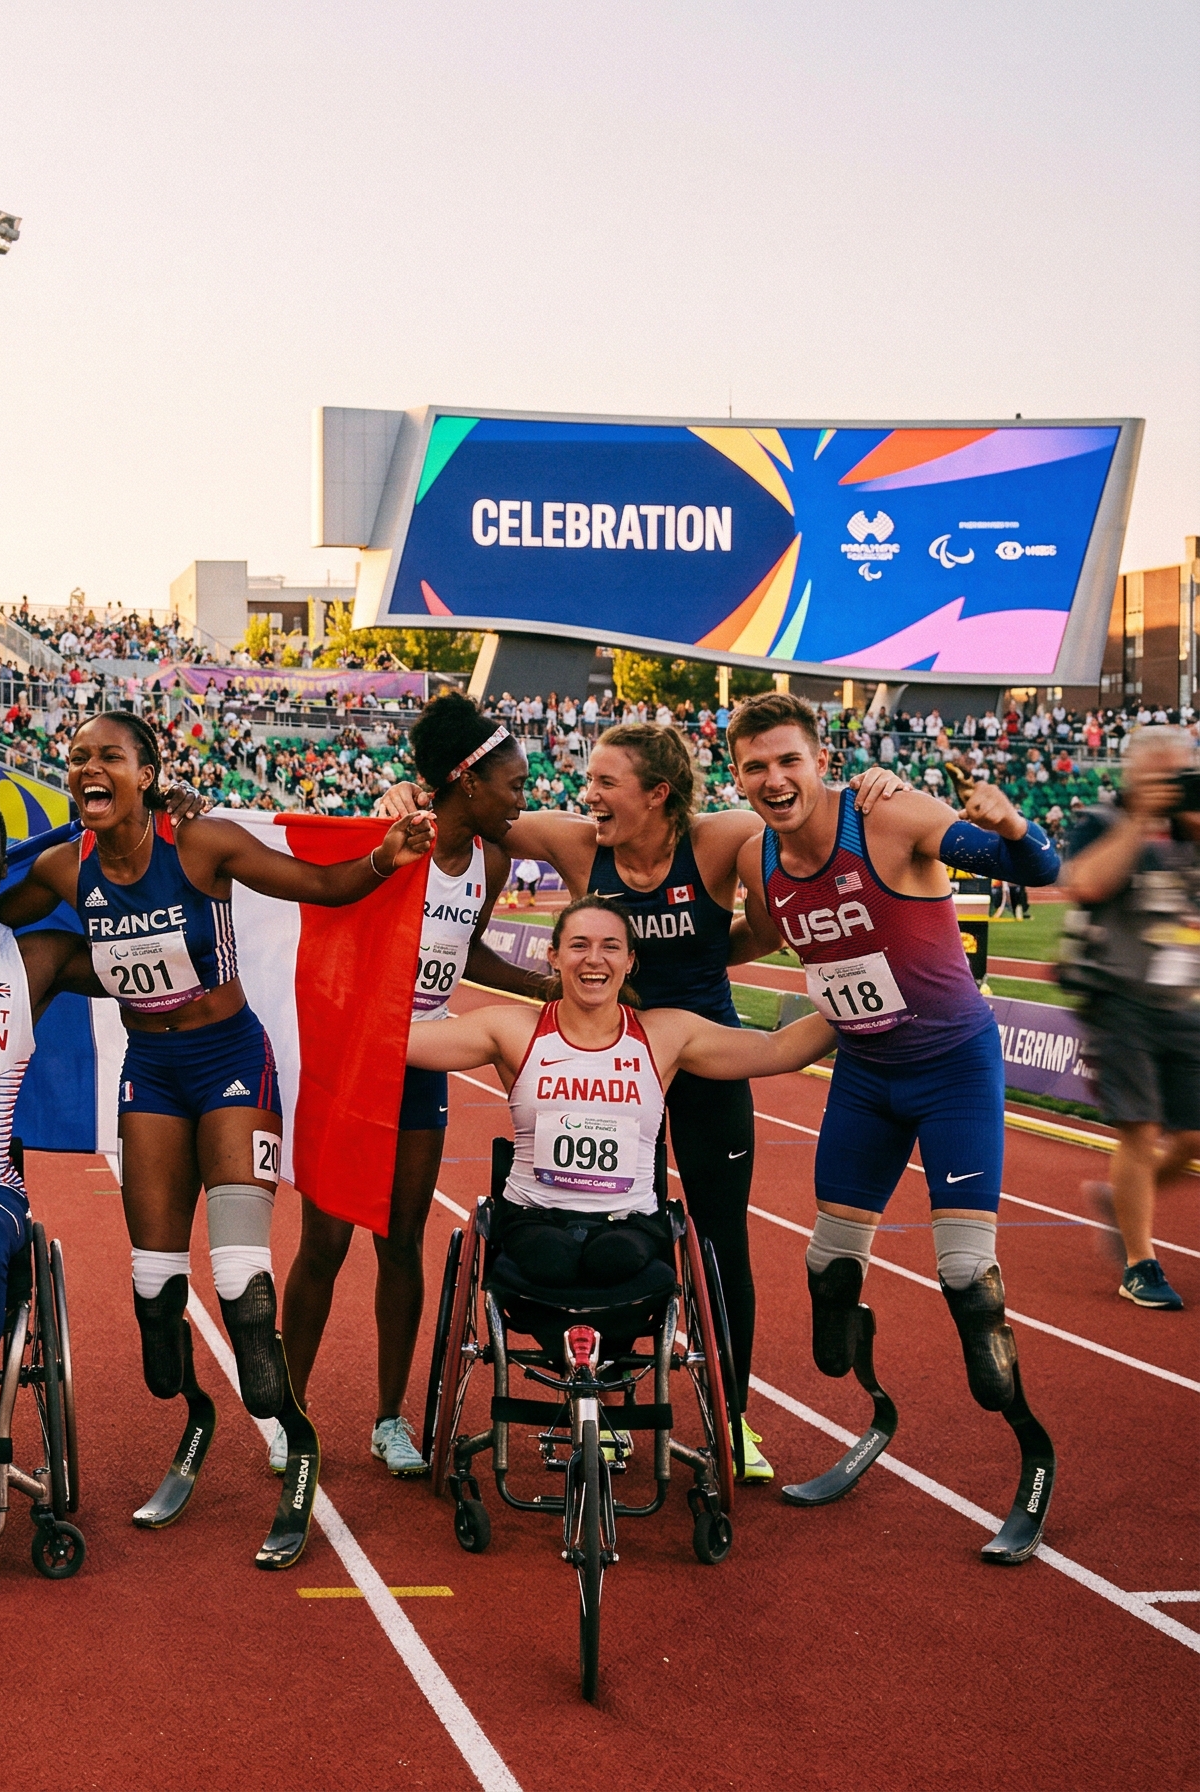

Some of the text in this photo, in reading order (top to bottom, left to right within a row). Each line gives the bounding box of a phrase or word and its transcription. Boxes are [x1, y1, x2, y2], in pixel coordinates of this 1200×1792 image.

[471, 498, 733, 552] CELEBRATION
[88, 904, 187, 937] FRANCE
[423, 901, 481, 926] RANCE
[628, 910, 696, 939] NADA
[781, 900, 875, 947] USA
[110, 959, 174, 996] 201
[417, 957, 457, 992] 98
[821, 980, 884, 1018] 118
[536, 1076, 642, 1106] CANADA
[553, 1134, 619, 1173] 098
